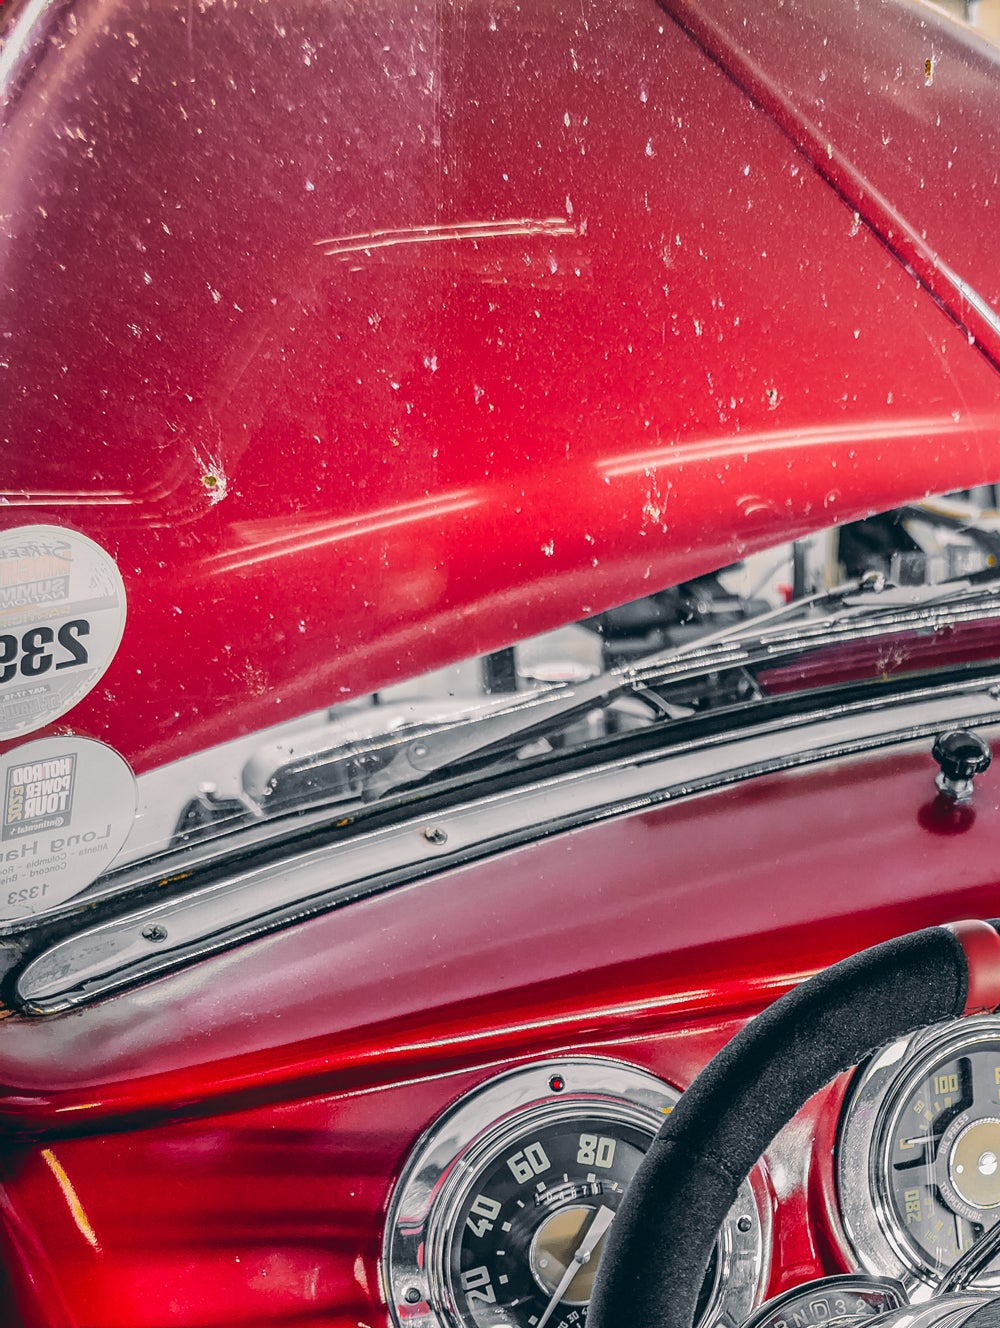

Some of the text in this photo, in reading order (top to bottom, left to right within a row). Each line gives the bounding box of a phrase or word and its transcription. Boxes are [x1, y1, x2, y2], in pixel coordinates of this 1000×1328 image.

[934, 1074, 958, 1095] 100
[506, 1142, 551, 1184] 60
[577, 1133, 616, 1168] 80
[466, 1194, 502, 1238] 40
[904, 1190, 921, 1225] 280
[460, 1265, 496, 1309] 20
[566, 1310, 580, 1324] 30
[792, 1309, 808, 1327] N
[835, 1299, 847, 1315] 3
[855, 1298, 866, 1314] 2
